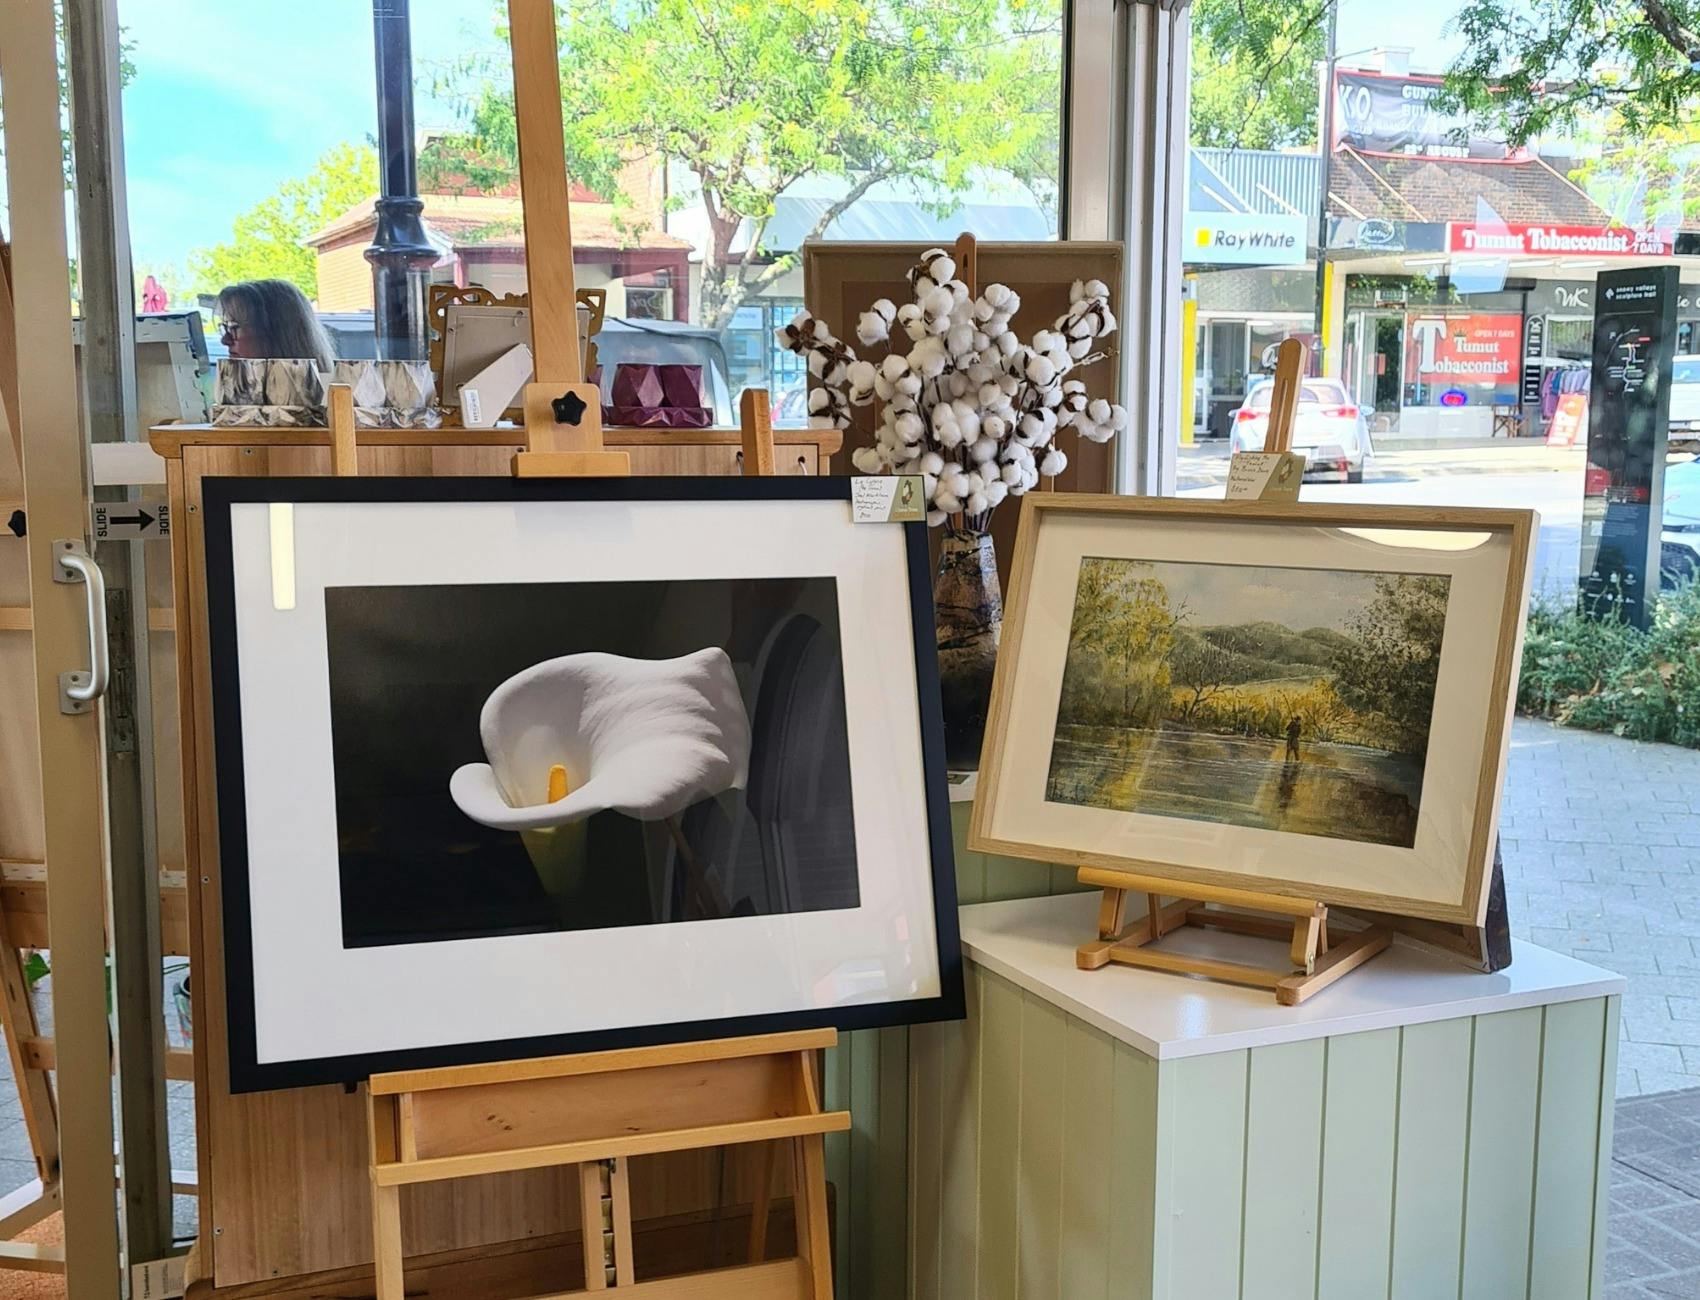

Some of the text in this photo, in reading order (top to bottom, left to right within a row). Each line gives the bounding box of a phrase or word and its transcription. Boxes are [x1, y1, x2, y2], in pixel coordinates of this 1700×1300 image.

[1215, 230, 1295, 250] Ray White
[1462, 227, 1632, 253] Tumut Tobacconist
[1635, 231, 1661, 242] OPEN
[1640, 242, 1665, 254] DAYS
[1453, 336, 1500, 353] Tumut
[96, 507, 108, 537] SLIDE
[158, 505, 170, 535] SLIDE
